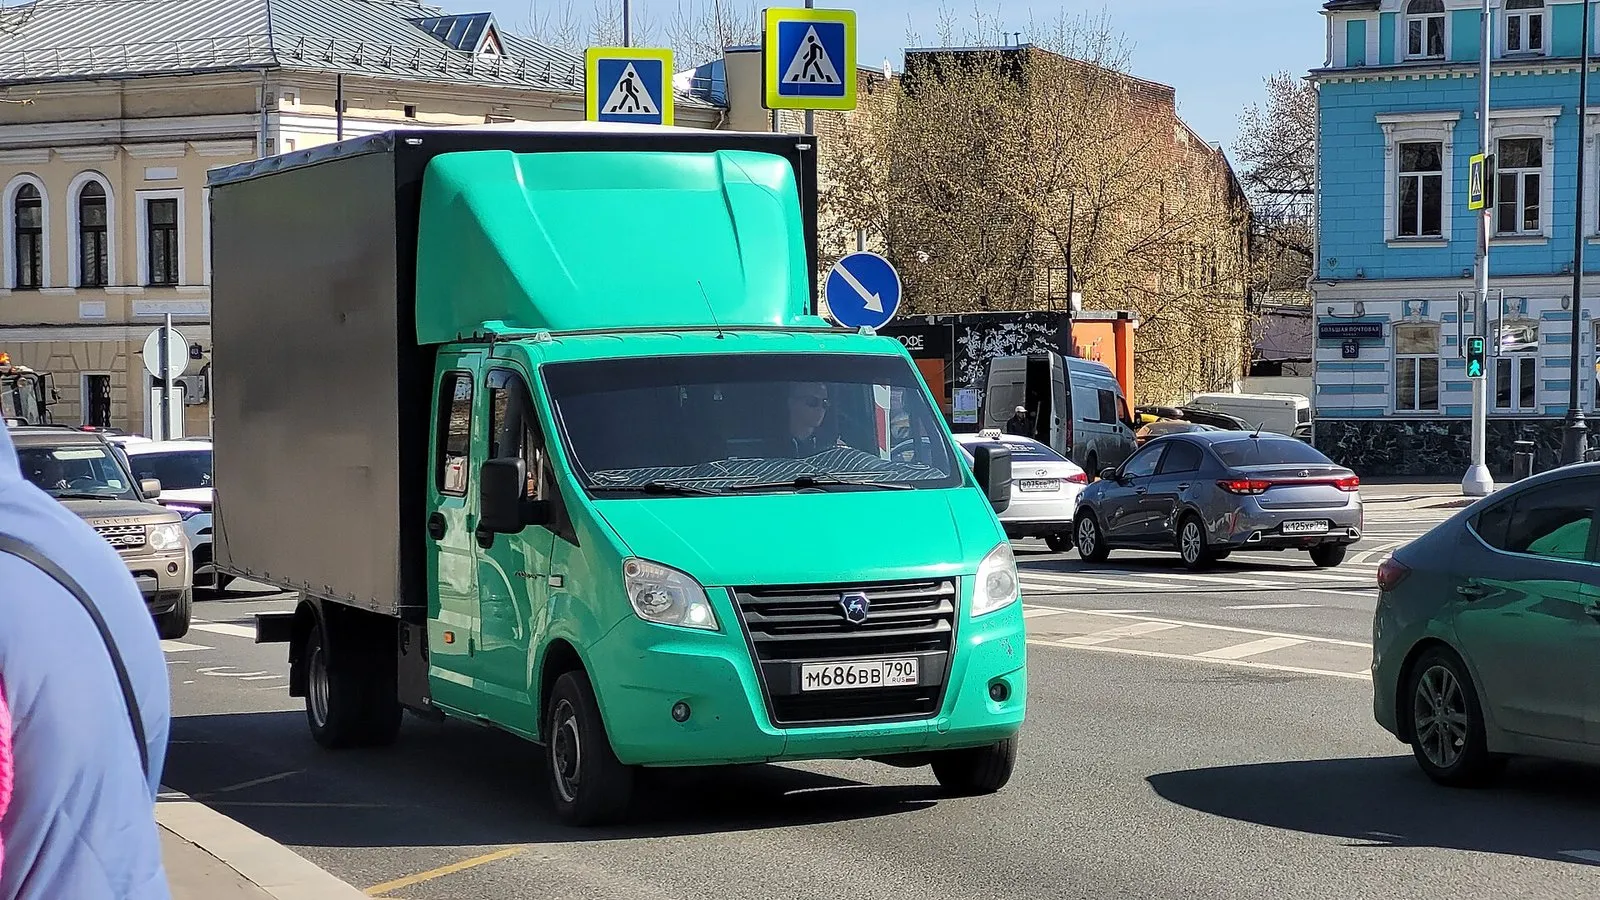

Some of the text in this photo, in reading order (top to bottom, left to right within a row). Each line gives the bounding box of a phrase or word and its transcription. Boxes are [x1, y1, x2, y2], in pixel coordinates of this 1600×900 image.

[1344, 345, 1356, 354] 38
[1474, 340, 1483, 353] 9
[807, 661, 913, 688] М686ВВ 790
